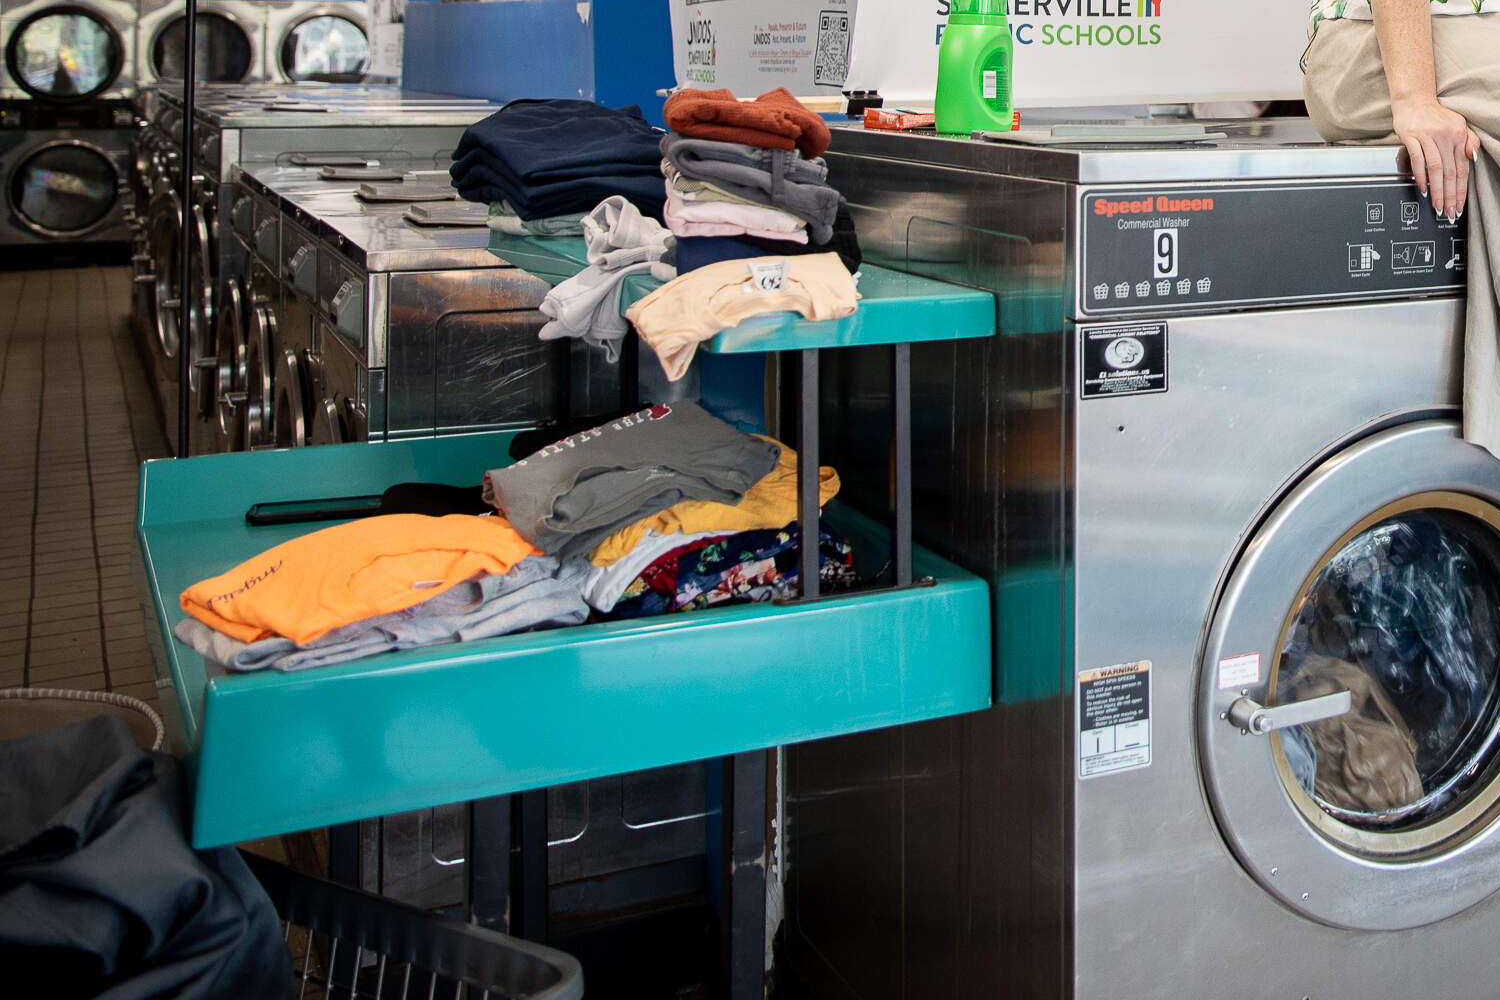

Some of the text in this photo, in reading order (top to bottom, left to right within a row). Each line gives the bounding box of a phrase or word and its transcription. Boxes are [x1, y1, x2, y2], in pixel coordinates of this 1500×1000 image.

[1041, 24, 1162, 46] SCHOOLS
[1093, 196, 1214, 218] Speed Queen
[1117, 216, 1190, 230] Commercial Washer
[1157, 232, 1174, 274] 9
[1100, 665, 1139, 677] WARNING
